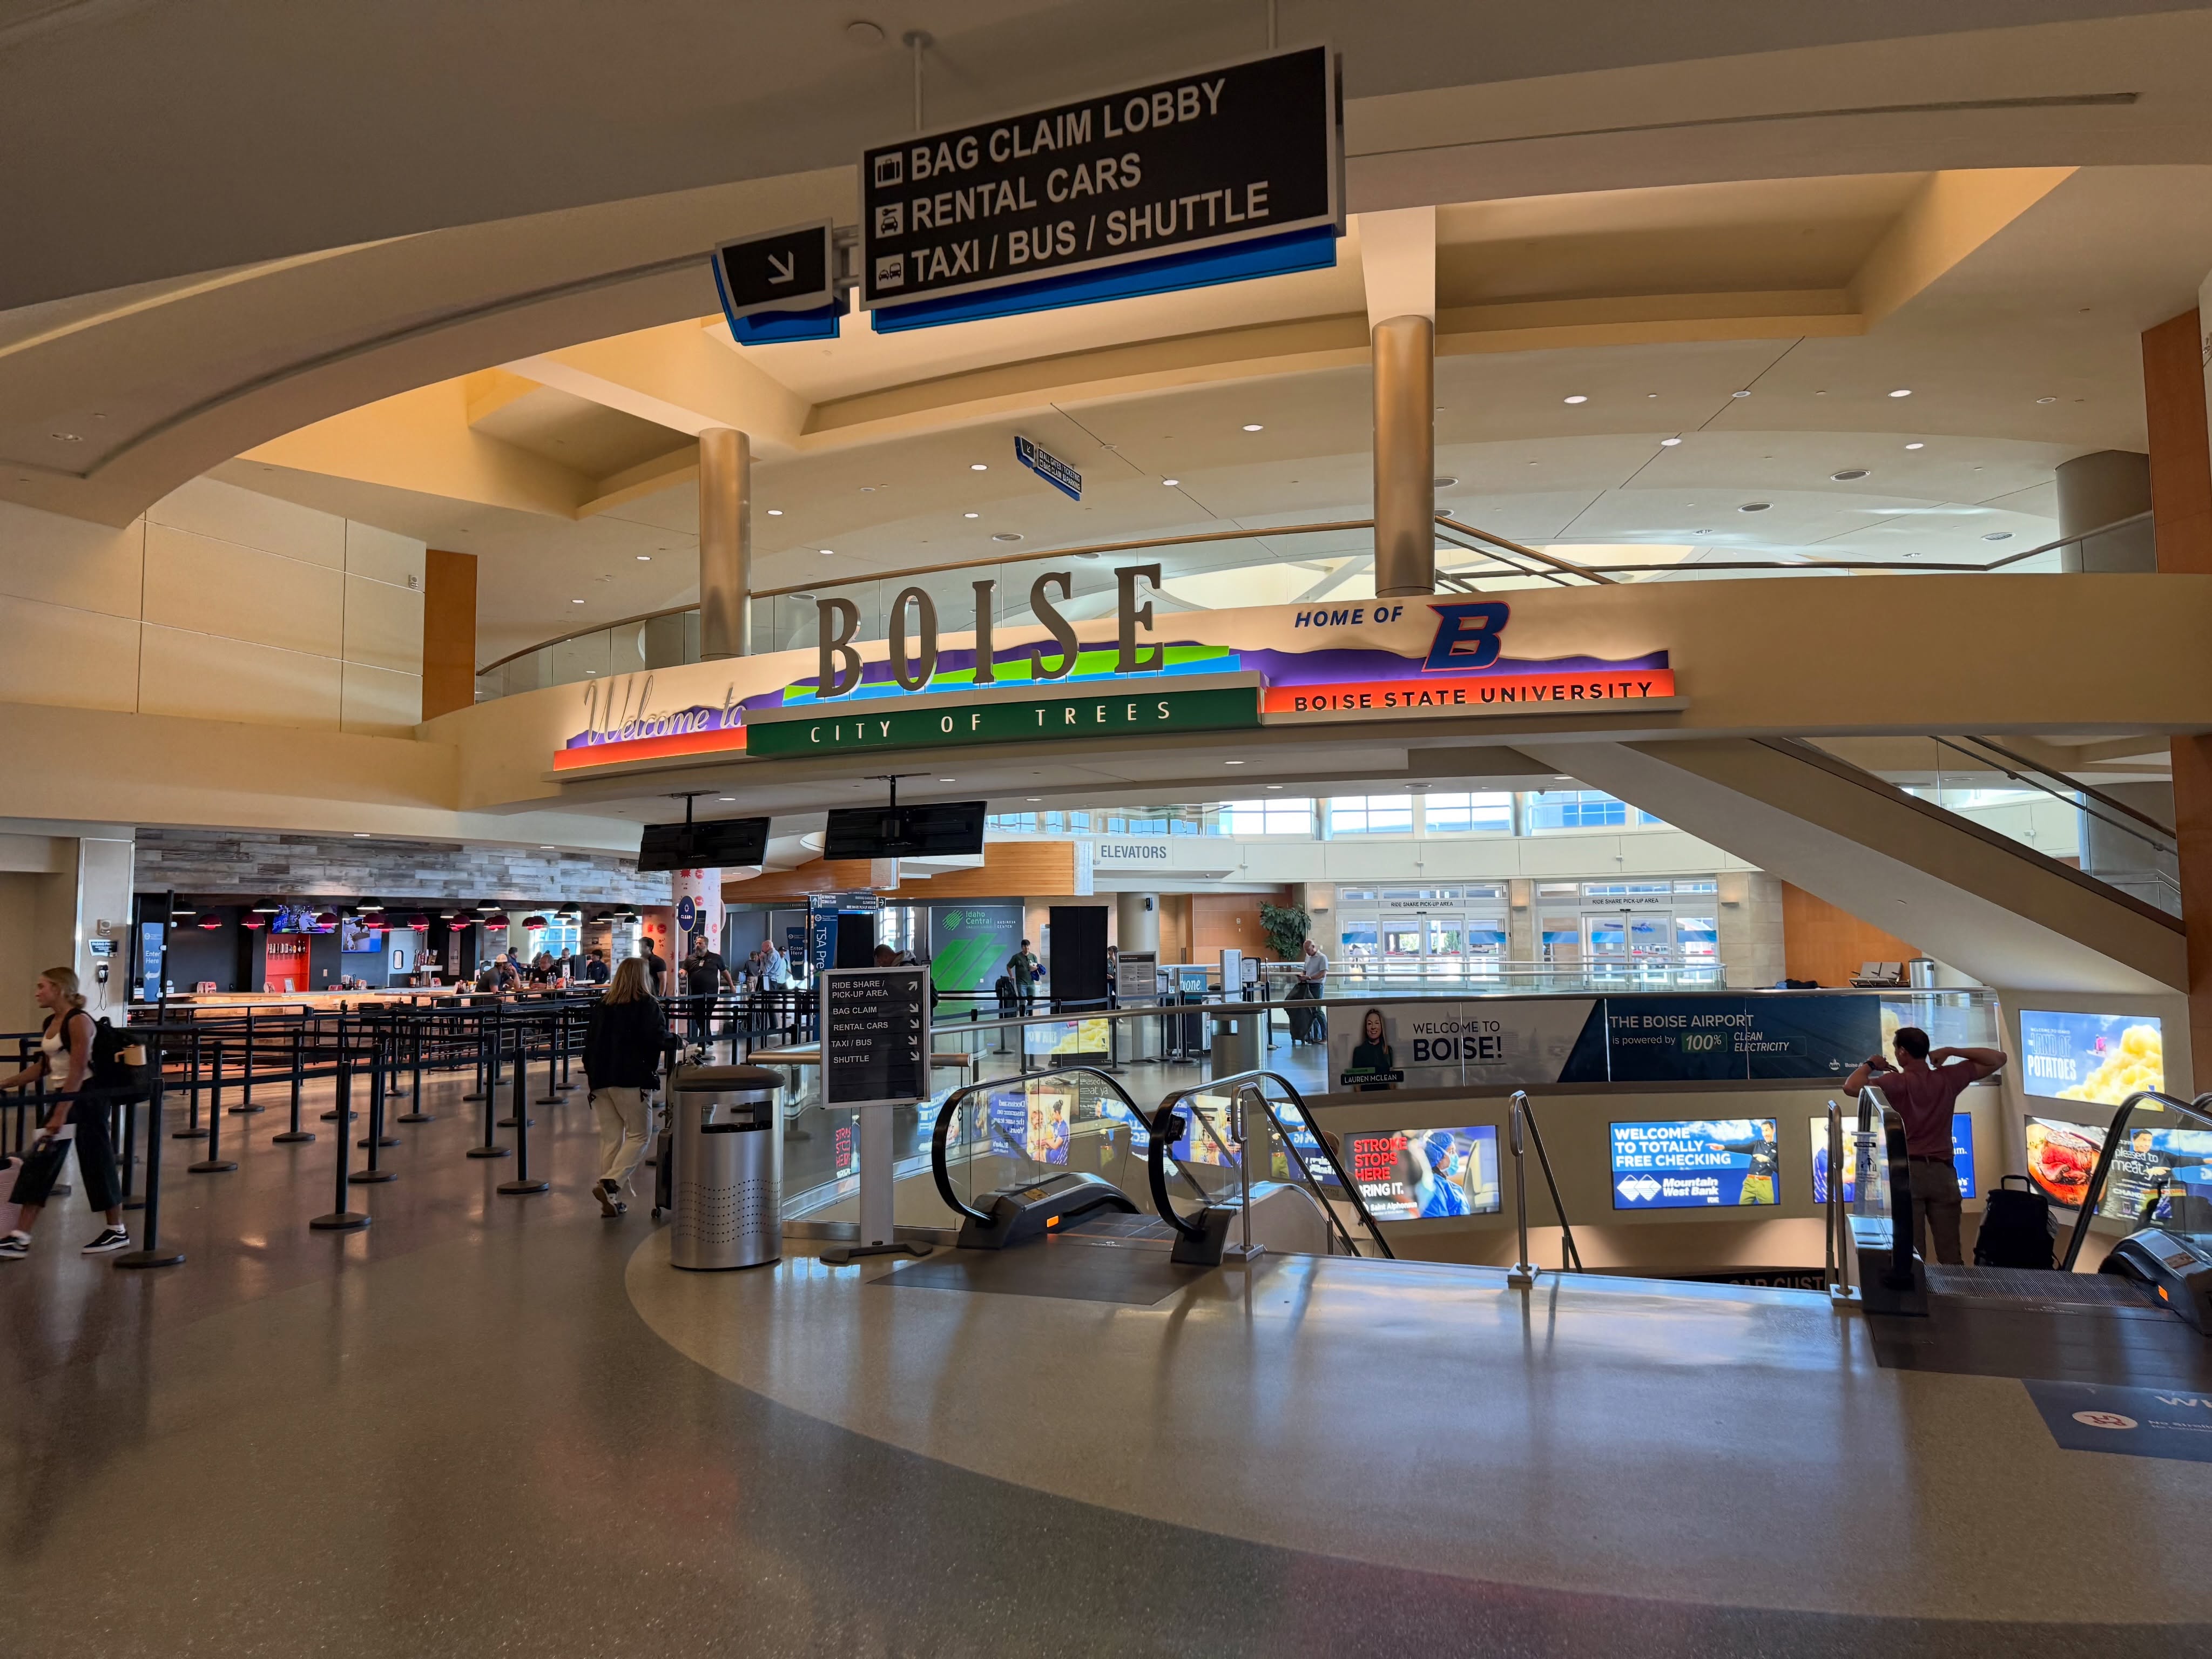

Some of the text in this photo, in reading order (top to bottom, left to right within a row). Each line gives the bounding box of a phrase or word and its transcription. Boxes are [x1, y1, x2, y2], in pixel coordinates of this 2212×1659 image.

[911, 78, 1225, 181] BAG CLAIM LOBBY
[911, 152, 1142, 230] RENTAL CARS
[911, 180, 1269, 283] TAXI / BUS / SHUTTLE
[1294, 605, 1404, 628] HOME OF
[816, 562, 1165, 698] BOISE
[1421, 601, 1512, 671] B
[1294, 682, 1654, 712] BOISE STATE UNIVERSITY
[584, 675, 747, 746] Welcome to
[810, 700, 1172, 744] CITY OF TREES
[1101, 844, 1167, 859] ELEVATORS
[816, 927, 827, 970] TSA Pre
[832, 990, 864, 999] PICK-UP
[852, 1006, 877, 1014] CLAIM
[1413, 1021, 1500, 1034] WELCOME TO
[1609, 1014, 1754, 1028] THE BOISE AIRPORT
[1612, 1034, 1722, 1051] is powered by 100%
[1734, 1031, 1763, 1041] CLEAN
[1413, 1036, 1502, 1062] BOISE!
[1734, 1042, 1790, 1053] ELECTRICITY
[2031, 1032, 2057, 1056] LAND
[2059, 1035, 2072, 1057] OF
[833, 1055, 869, 1063] SHUTTLE
[2027, 1054, 2077, 1081] POTATOES
[1344, 1074, 1397, 1084] LAUREN MCLEAN
[1614, 1128, 1690, 1141] WELCOME
[1354, 1137, 1408, 1153] STROKE
[1614, 1140, 1704, 1154] TO TOTALLY
[1354, 1152, 1398, 1168] STOPS
[1616, 1153, 1731, 1167] FREE CHECKING
[2148, 1152, 2159, 1163] to
[1355, 1166, 1391, 1182] HERE
[2110, 1159, 2144, 1175] meat
[1392, 1182, 1404, 1195] IT.
[1663, 1177, 1718, 1188] Mountain
[1663, 1186, 1719, 1197] West Bank
[1370, 1203, 1386, 1211] Saint
